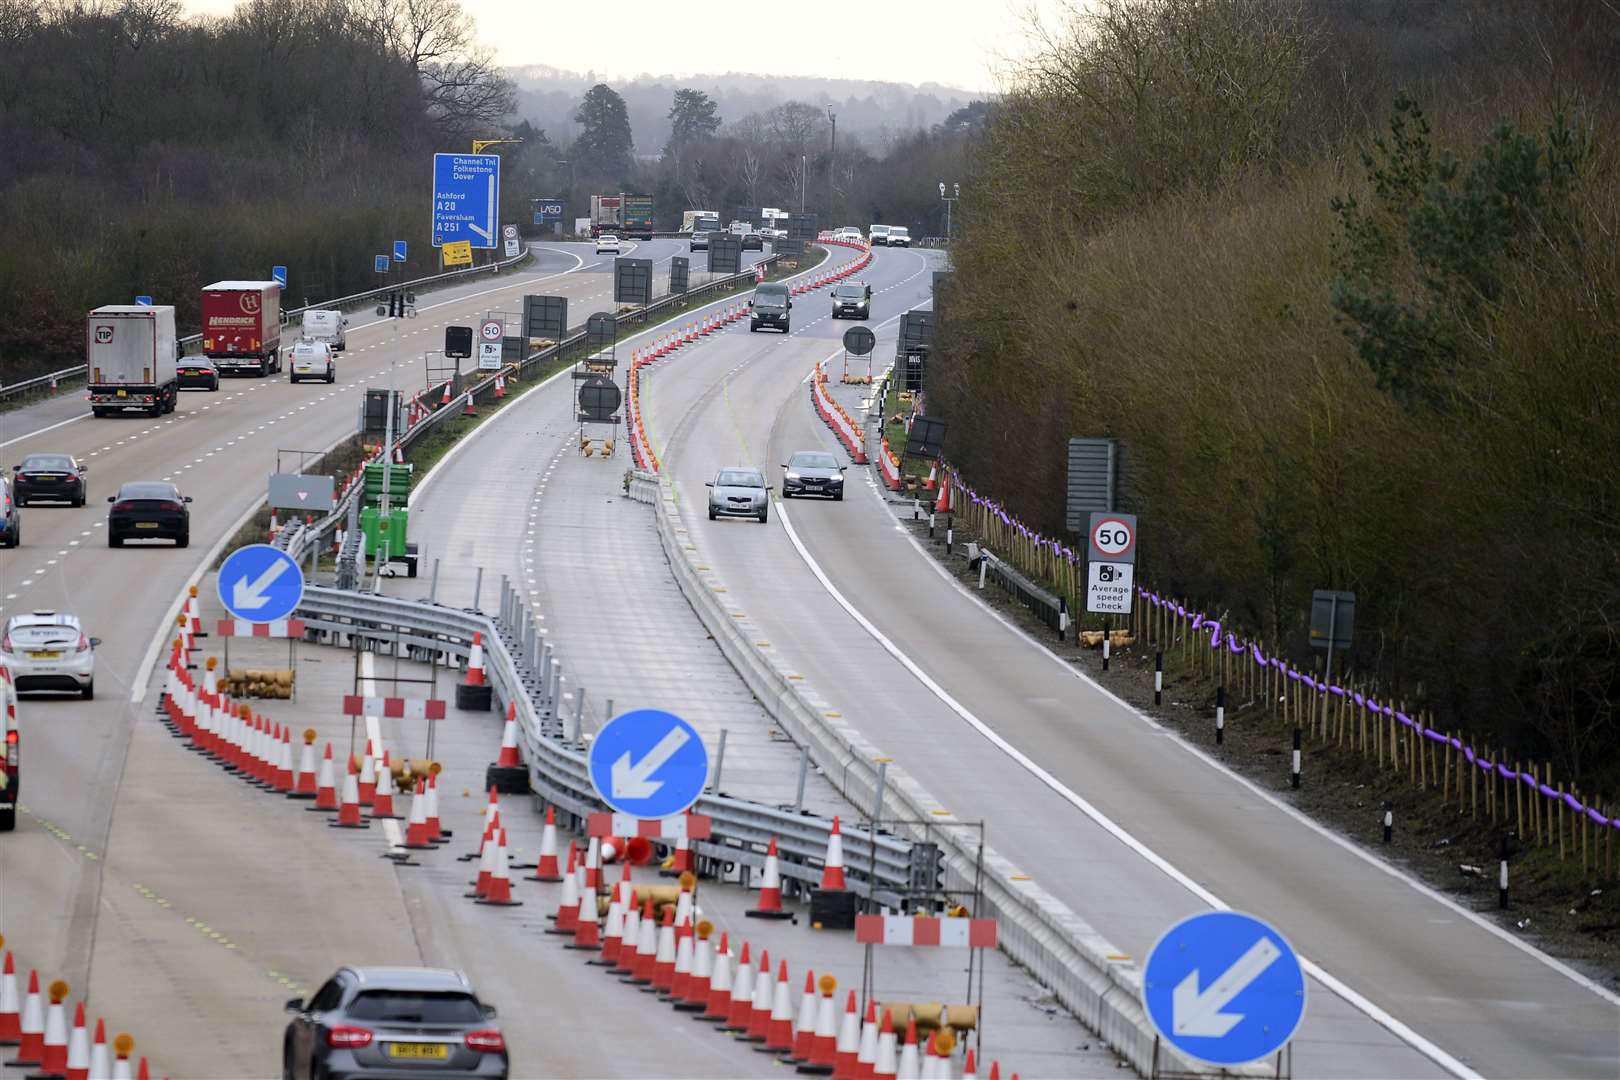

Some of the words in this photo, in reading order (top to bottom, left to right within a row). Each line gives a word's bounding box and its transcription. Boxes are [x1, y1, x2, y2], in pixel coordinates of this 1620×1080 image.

[453, 157, 483, 165] Channel
[485, 158, 497, 166] Tnl
[453, 165, 493, 174] Folkestone
[437, 192, 465, 200] Ashford
[437, 213, 475, 221] Faversham
[208, 316, 256, 326] HENDRICK
[98, 331, 112, 340] TIP
[485, 327, 499, 335] 50
[1100, 530, 1128, 546] 50
[1092, 584, 1130, 594] Average
[1096, 594, 1123, 602] speed
[1096, 602, 1123, 610] check
